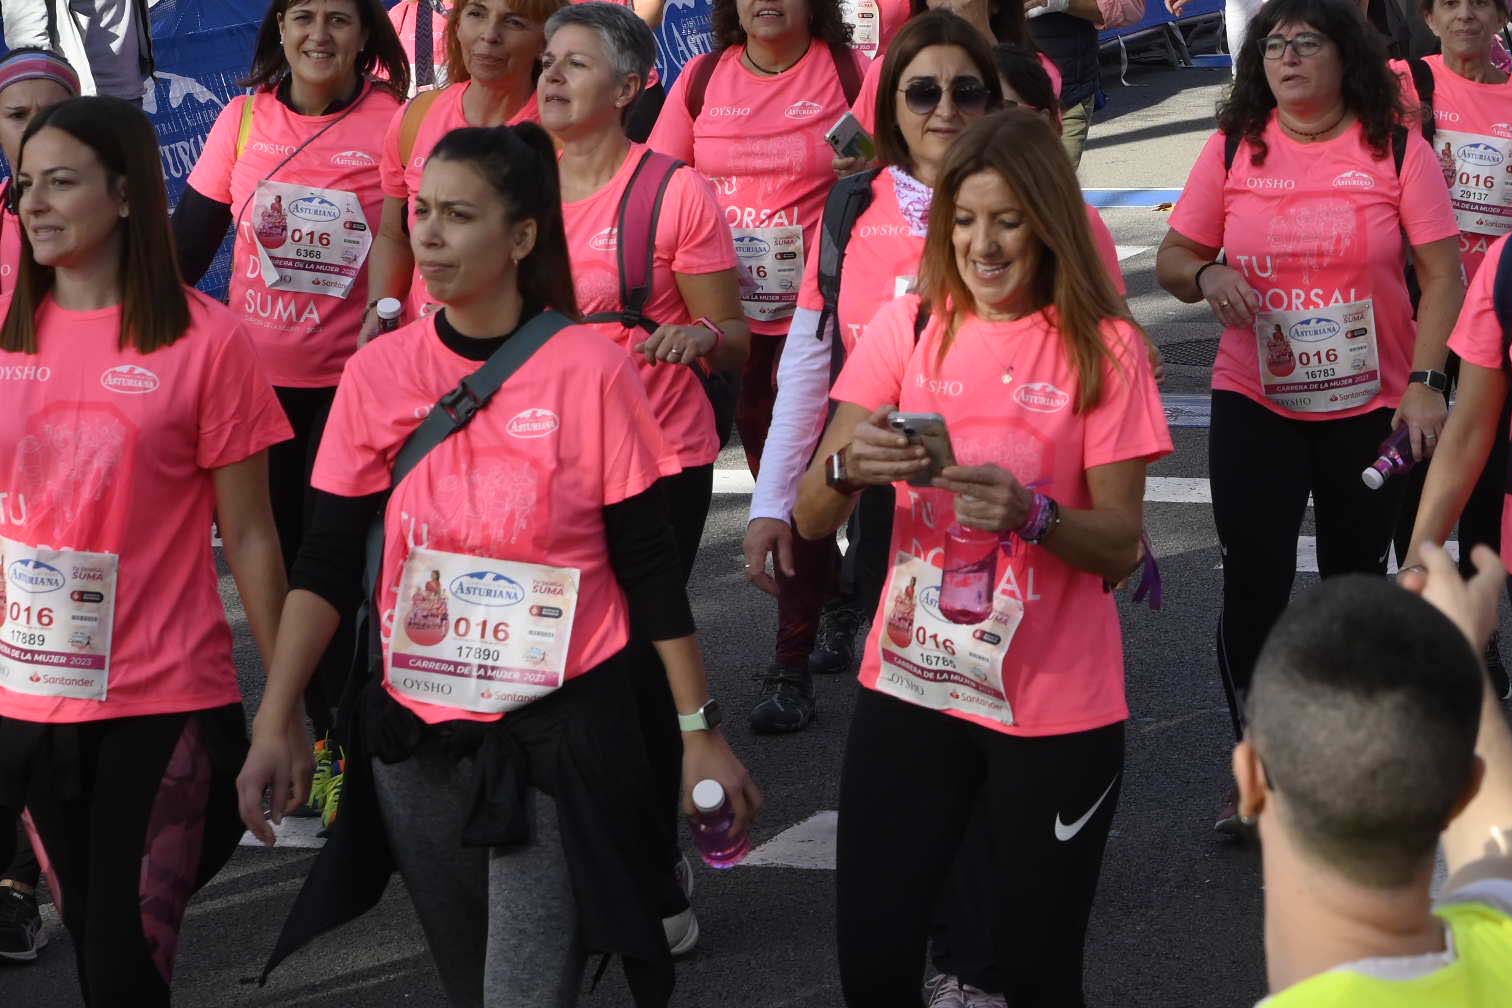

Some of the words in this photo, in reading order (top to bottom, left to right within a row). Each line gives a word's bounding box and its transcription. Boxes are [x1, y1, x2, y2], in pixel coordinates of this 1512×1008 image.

[709, 107, 751, 117] OYSHO
[1247, 177, 1296, 190] OYSHO
[1459, 172, 1496, 189] 016
[1460, 189, 1489, 201] 29137
[290, 228, 331, 246] 016
[296, 248, 321, 259] 6368
[1236, 254, 1273, 279] TU
[244, 288, 321, 325] SUMA
[1293, 325, 1337, 338] ASTURIANA
[1298, 348, 1338, 366] 016
[1305, 367, 1336, 380] 16783
[72, 571, 104, 582] SUMA
[455, 581, 519, 601] ASTURIANA
[531, 584, 565, 596] SUMA
[9, 601, 55, 627] 016
[453, 616, 511, 642] 016
[11, 629, 46, 647] 17889
[916, 626, 956, 656] 016
[33, 653, 67, 665] MUJER
[457, 646, 500, 662] 17890
[408, 658, 455, 673] CARRERA
[457, 665, 472, 675] DE
[472, 667, 485, 677] LA
[486, 669, 521, 680] MUJER
[923, 671, 934, 680] DE
[936, 672, 949, 680] LA
[43, 674, 95, 688] Santander
[402, 677, 453, 695] OYSHO
